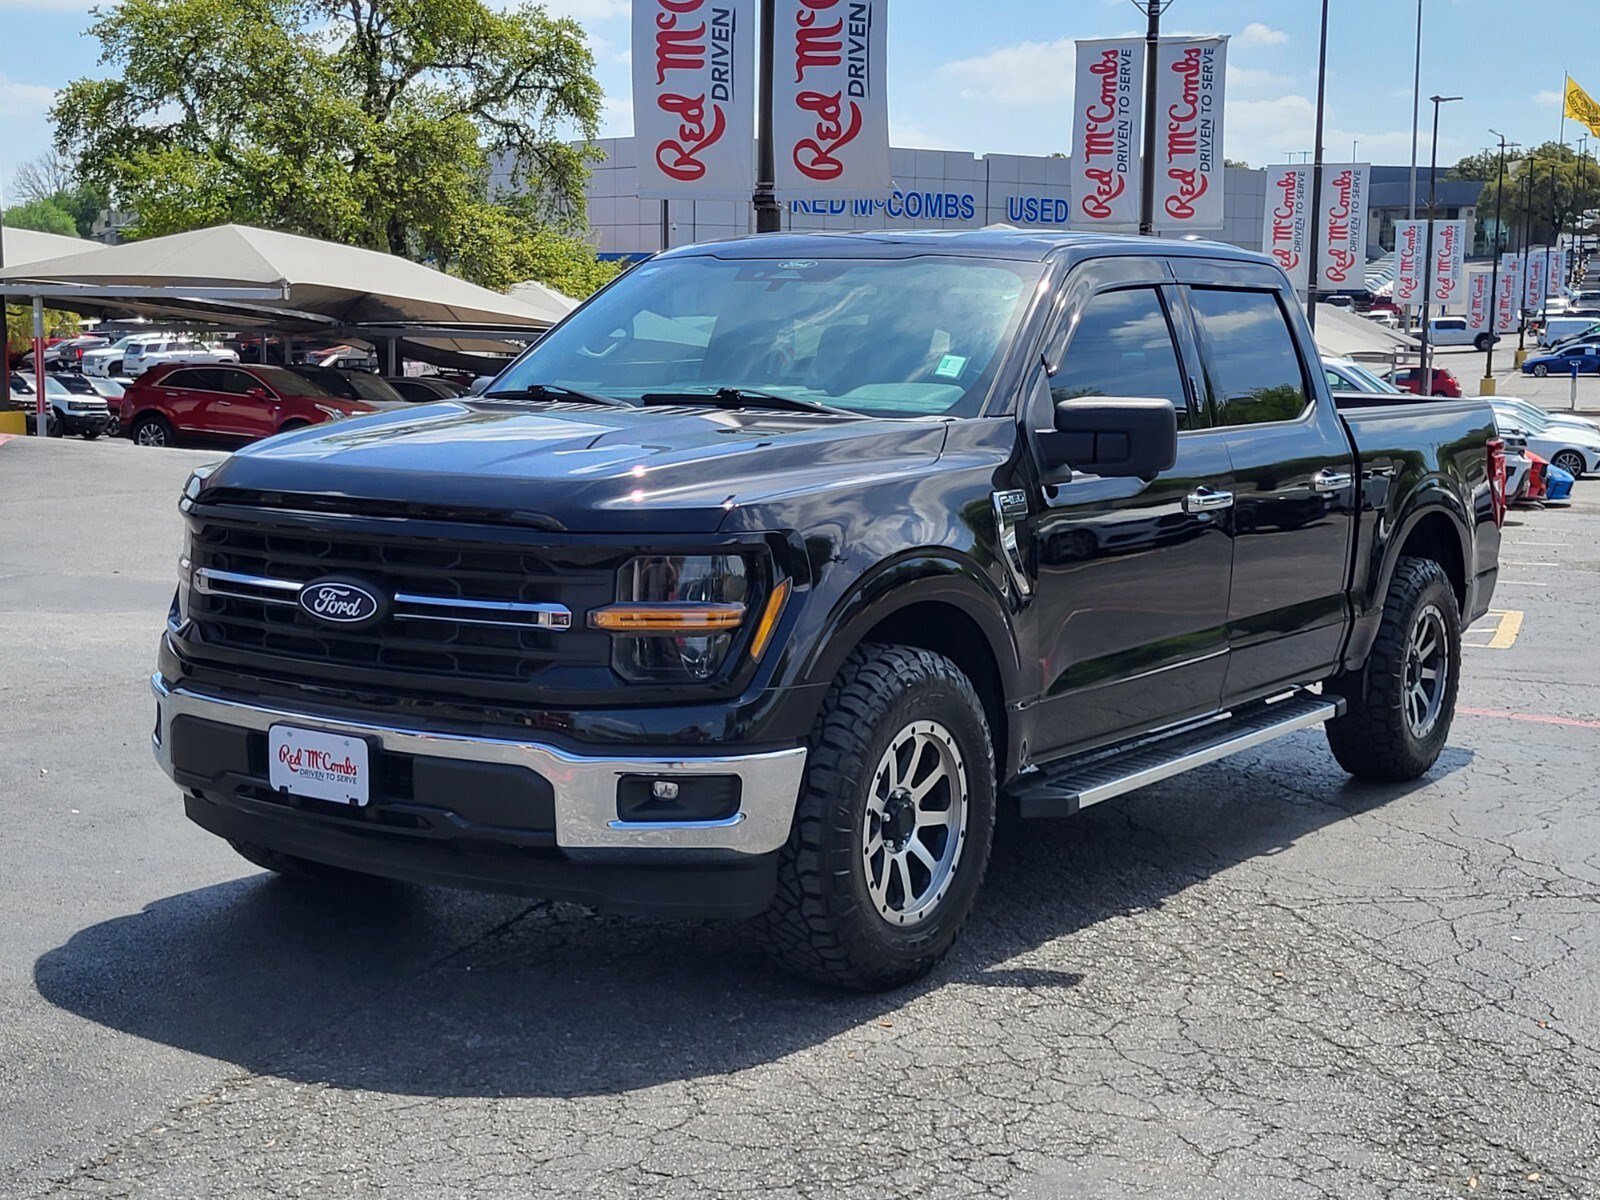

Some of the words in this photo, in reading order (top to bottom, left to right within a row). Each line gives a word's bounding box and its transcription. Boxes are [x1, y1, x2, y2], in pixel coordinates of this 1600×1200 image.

[712, 7, 730, 102] DRIVEN
[847, 3, 867, 98] DRIVEN
[1202, 48, 1214, 91] SERVE
[1119, 49, 1132, 92] SERVE
[1085, 49, 1119, 164] McCombs
[1119, 96, 1130, 115] TO
[1167, 48, 1201, 164] McCombs
[1201, 95, 1212, 115] TO
[656, 93, 726, 181] Red
[793, 90, 862, 181] Red
[1117, 120, 1129, 173] DRIVEN
[1200, 119, 1212, 172] DRIVEN
[1082, 168, 1125, 219] Red
[1165, 168, 1208, 219] Red
[1297, 171, 1305, 199] SERVE
[1352, 170, 1361, 199] SERVE
[1009, 196, 1069, 223] USED
[1272, 171, 1297, 246] McCombs
[1296, 202, 1304, 215] TO
[1328, 170, 1352, 246] McCombs
[1351, 202, 1359, 214] TO
[1294, 218, 1303, 253] DRIVEN
[1350, 217, 1358, 252] DRIVEN
[1400, 225, 1416, 275] McCombs
[1437, 225, 1453, 275] McCombs
[1272, 249, 1299, 271] ed
[1326, 249, 1355, 282] Red
[1398, 277, 1418, 299] Red
[1435, 277, 1456, 299] Red
[314, 587, 361, 616] Ford
[279, 744, 302, 773] Red
[304, 748, 357, 776] McCombs
[300, 769, 325, 779] DRIVEN
[326, 773, 335, 781] TO
[336, 775, 357, 785] SERVE
